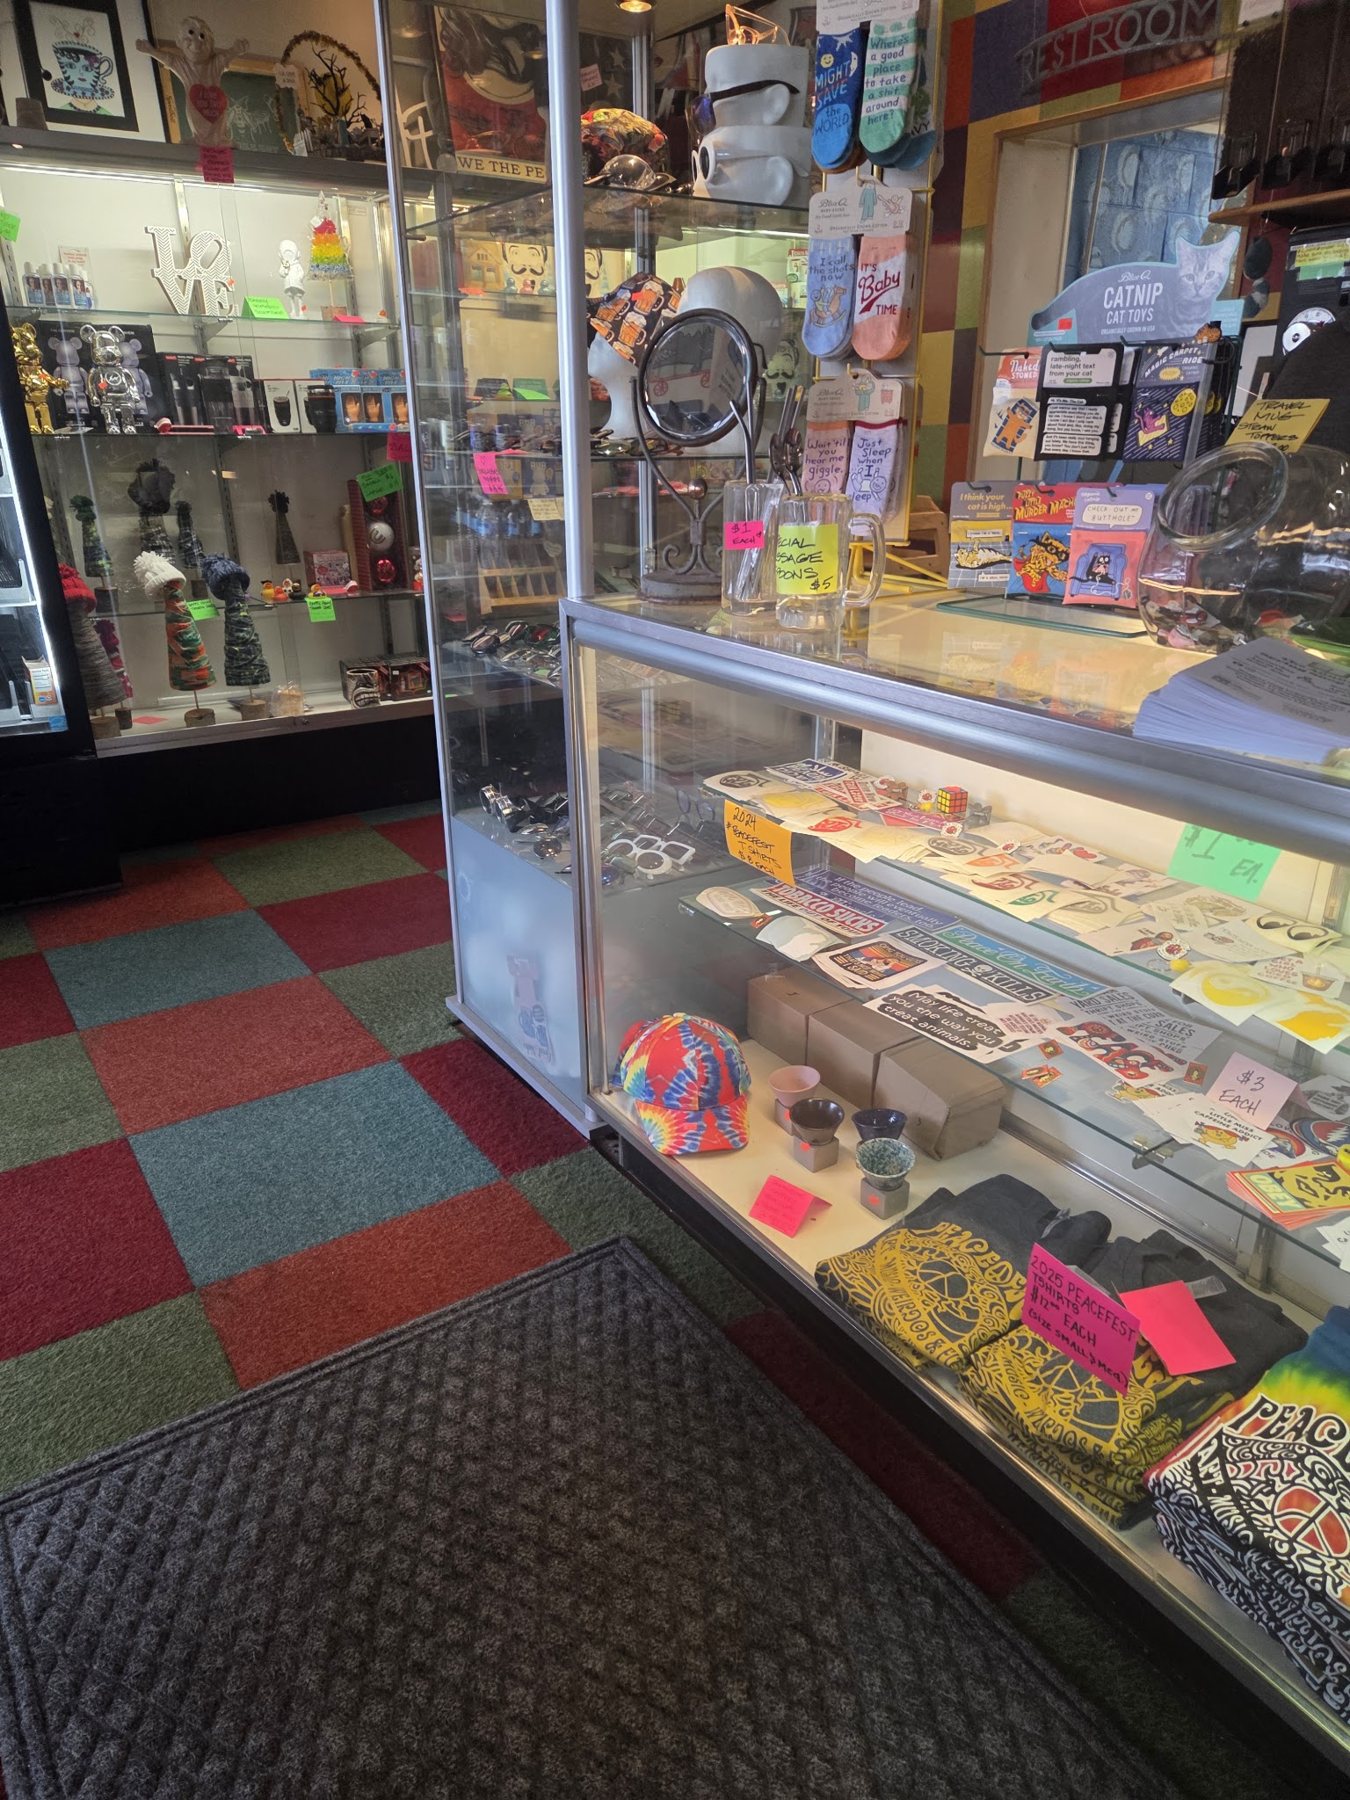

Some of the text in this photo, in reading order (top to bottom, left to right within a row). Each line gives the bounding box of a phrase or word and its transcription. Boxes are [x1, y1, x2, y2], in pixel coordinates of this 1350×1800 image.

[870, 36, 910, 49] Where's
[1020, 0, 1215, 91] RESTROOM
[881, 50, 904, 63] good
[815, 61, 850, 88] MIGHT
[873, 64, 901, 77] place
[865, 74, 906, 88] to take
[815, 82, 848, 109] SAVE
[878, 88, 899, 97] shit
[826, 106, 841, 118] the
[866, 98, 899, 114] around
[815, 113, 849, 135] WORLD
[867, 111, 895, 125] here?
[458, 157, 485, 171] WE
[489, 160, 522, 176] THE
[809, 262, 854, 274] the shots
[820, 254, 846, 266] I call
[861, 263, 877, 272] IT'S
[821, 273, 844, 281] now
[858, 271, 901, 304] Baby
[1104, 283, 1163, 309] CATNIP
[876, 305, 898, 315] TIME
[1107, 308, 1154, 324] CAT TOYS
[1010, 360, 1040, 372] Naked
[807, 440, 831, 449] Wait
[857, 438, 883, 448] Just
[805, 454, 826, 464] hear
[818, 450, 836, 458] you
[862, 448, 891, 458] Sleep
[809, 465, 843, 480] giggle.
[864, 465, 873, 477] I
[1014, 504, 1047, 520] MURDER
[810, 577, 833, 590] $5
[733, 807, 756, 832] 2024
[769, 885, 835, 913] TOBACCO
[826, 908, 879, 932] SUCKS
[898, 929, 971, 970] SMOKING
[986, 970, 1045, 1003] KILLS
[1032, 962, 1091, 998] Earth
[1070, 991, 1135, 1009] YARD SALES
[889, 996, 996, 1045] you the way you
[909, 992, 941, 1006] May
[940, 1004, 964, 1018] life
[965, 1017, 1001, 1035] treat
[884, 1005, 971, 1048] treat animals.
[1155, 1019, 1196, 1037] SALES
[1236, 1070, 1265, 1092] $3
[1219, 1089, 1263, 1116] EACH
[1194, 1110, 1262, 1140] CAFFEINE ADDICT
[1209, 1111, 1254, 1132] LITTLE MISS
[1250, 1173, 1302, 1208] OBEY
[1030, 1256, 1064, 1288] 2025
[1032, 1272, 1080, 1315] TSHIRTS
[888, 1287, 936, 1341] WEIRDOS
[925, 1338, 945, 1354] &
[1068, 1282, 1136, 1341] PEACEFEST
[1028, 1308, 1052, 1331] (SIZE
[1055, 1330, 1089, 1358] SMALL
[1064, 1313, 1097, 1346] EACH
[1198, 1438, 1254, 1545] ART MUSIC
